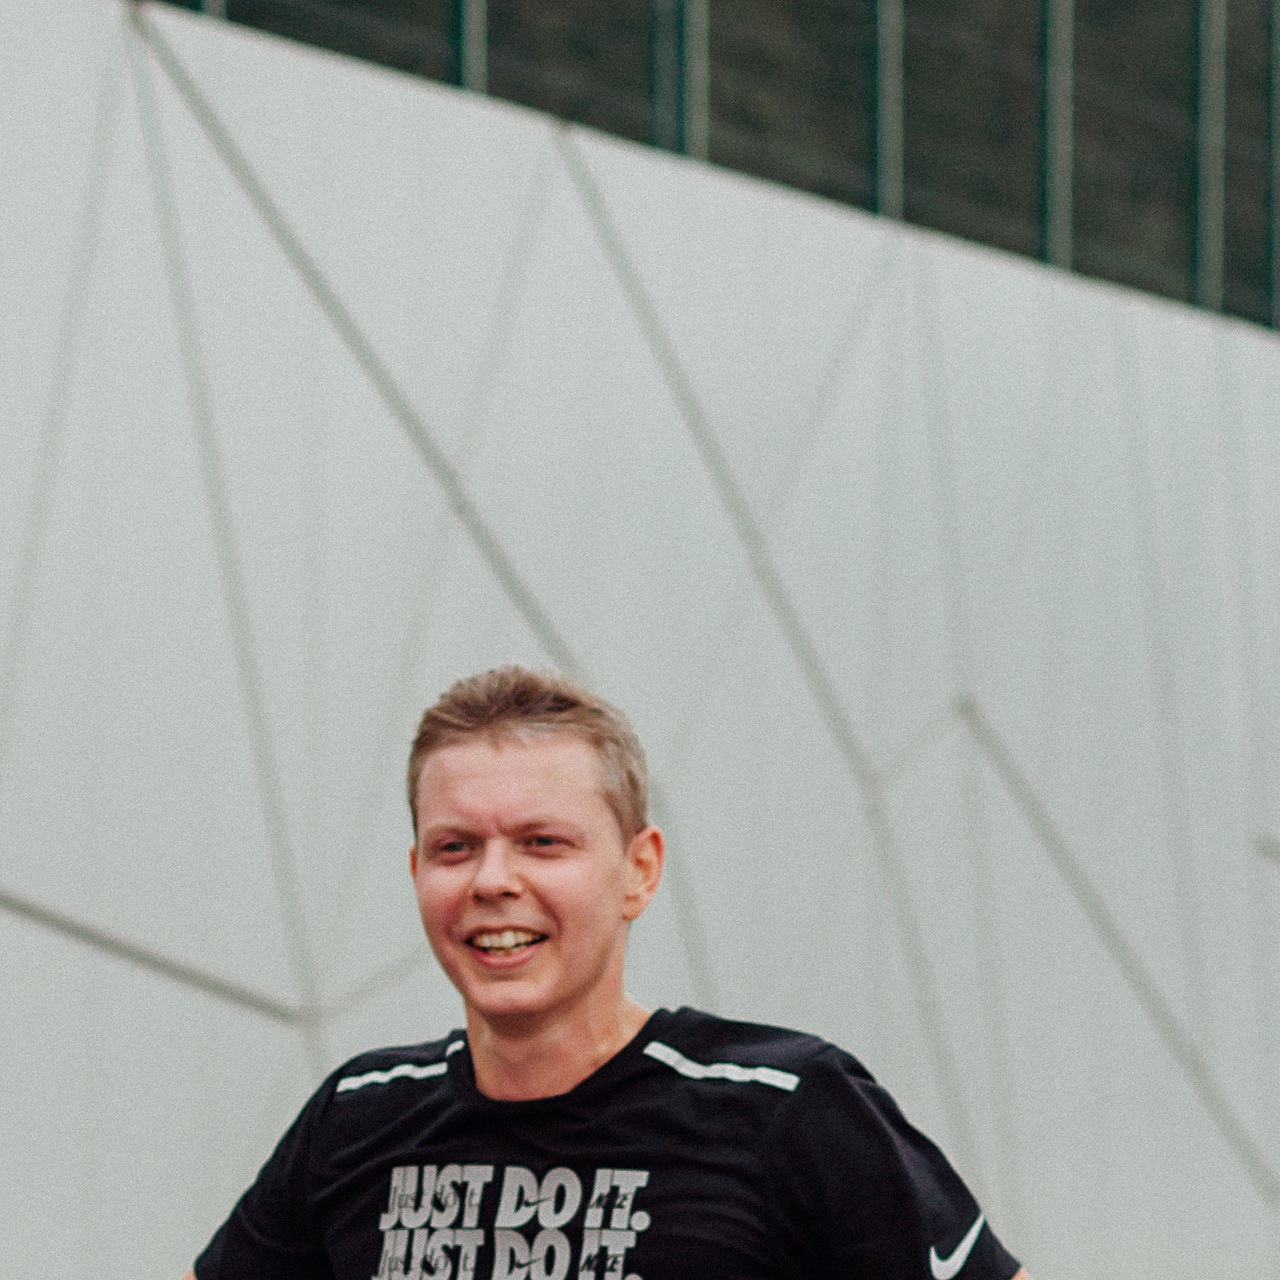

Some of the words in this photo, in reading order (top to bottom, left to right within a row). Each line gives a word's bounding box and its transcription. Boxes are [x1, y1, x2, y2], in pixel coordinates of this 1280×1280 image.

[379, 1165, 494, 1230] JUST
[495, 1166, 583, 1229] DO
[584, 1168, 651, 1231] IT.
